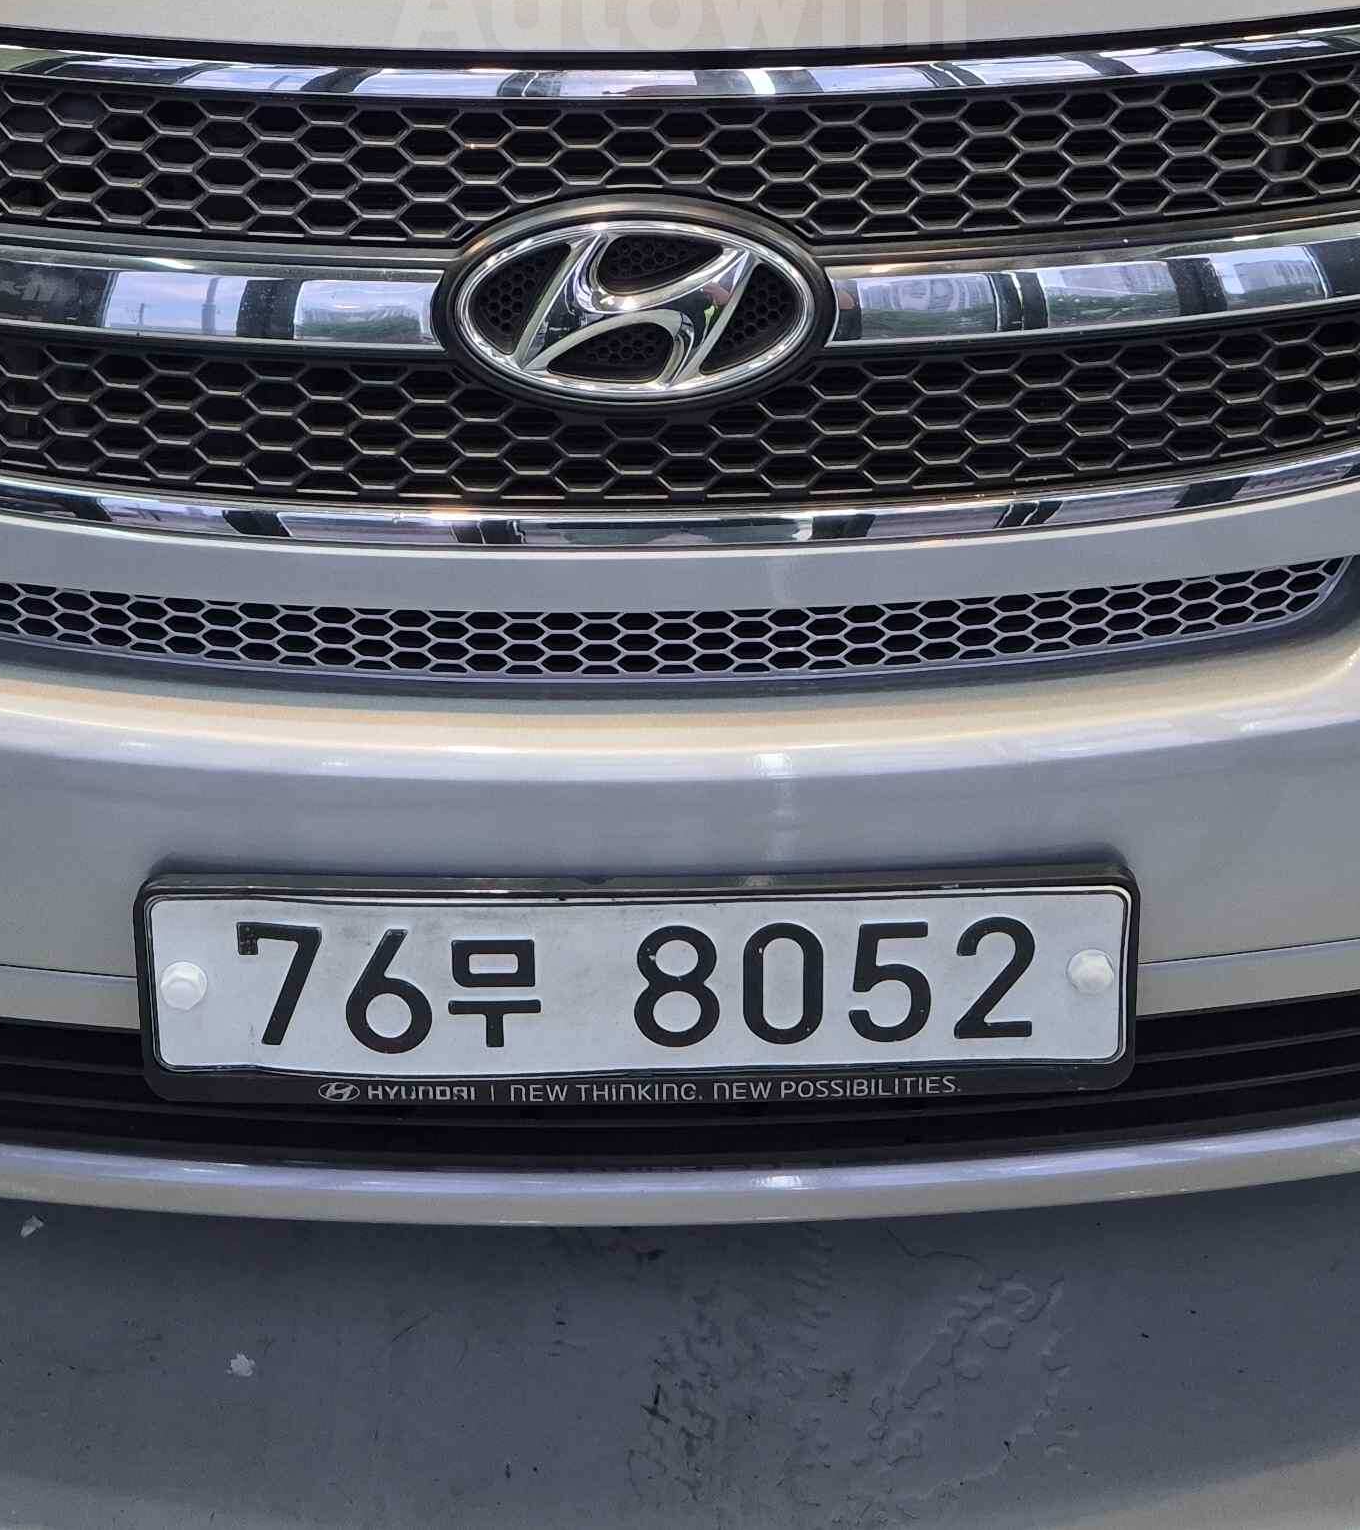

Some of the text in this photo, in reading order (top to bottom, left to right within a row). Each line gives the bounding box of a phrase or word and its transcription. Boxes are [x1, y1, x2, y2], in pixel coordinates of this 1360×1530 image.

[236, 916, 1038, 1054] 76무 8052
[366, 1083, 476, 1101] HYUNDAI
[509, 1083, 567, 1102] NEW
[713, 1081, 772, 1101] NEW
[779, 1076, 962, 1099] POSSIBILITIES.
